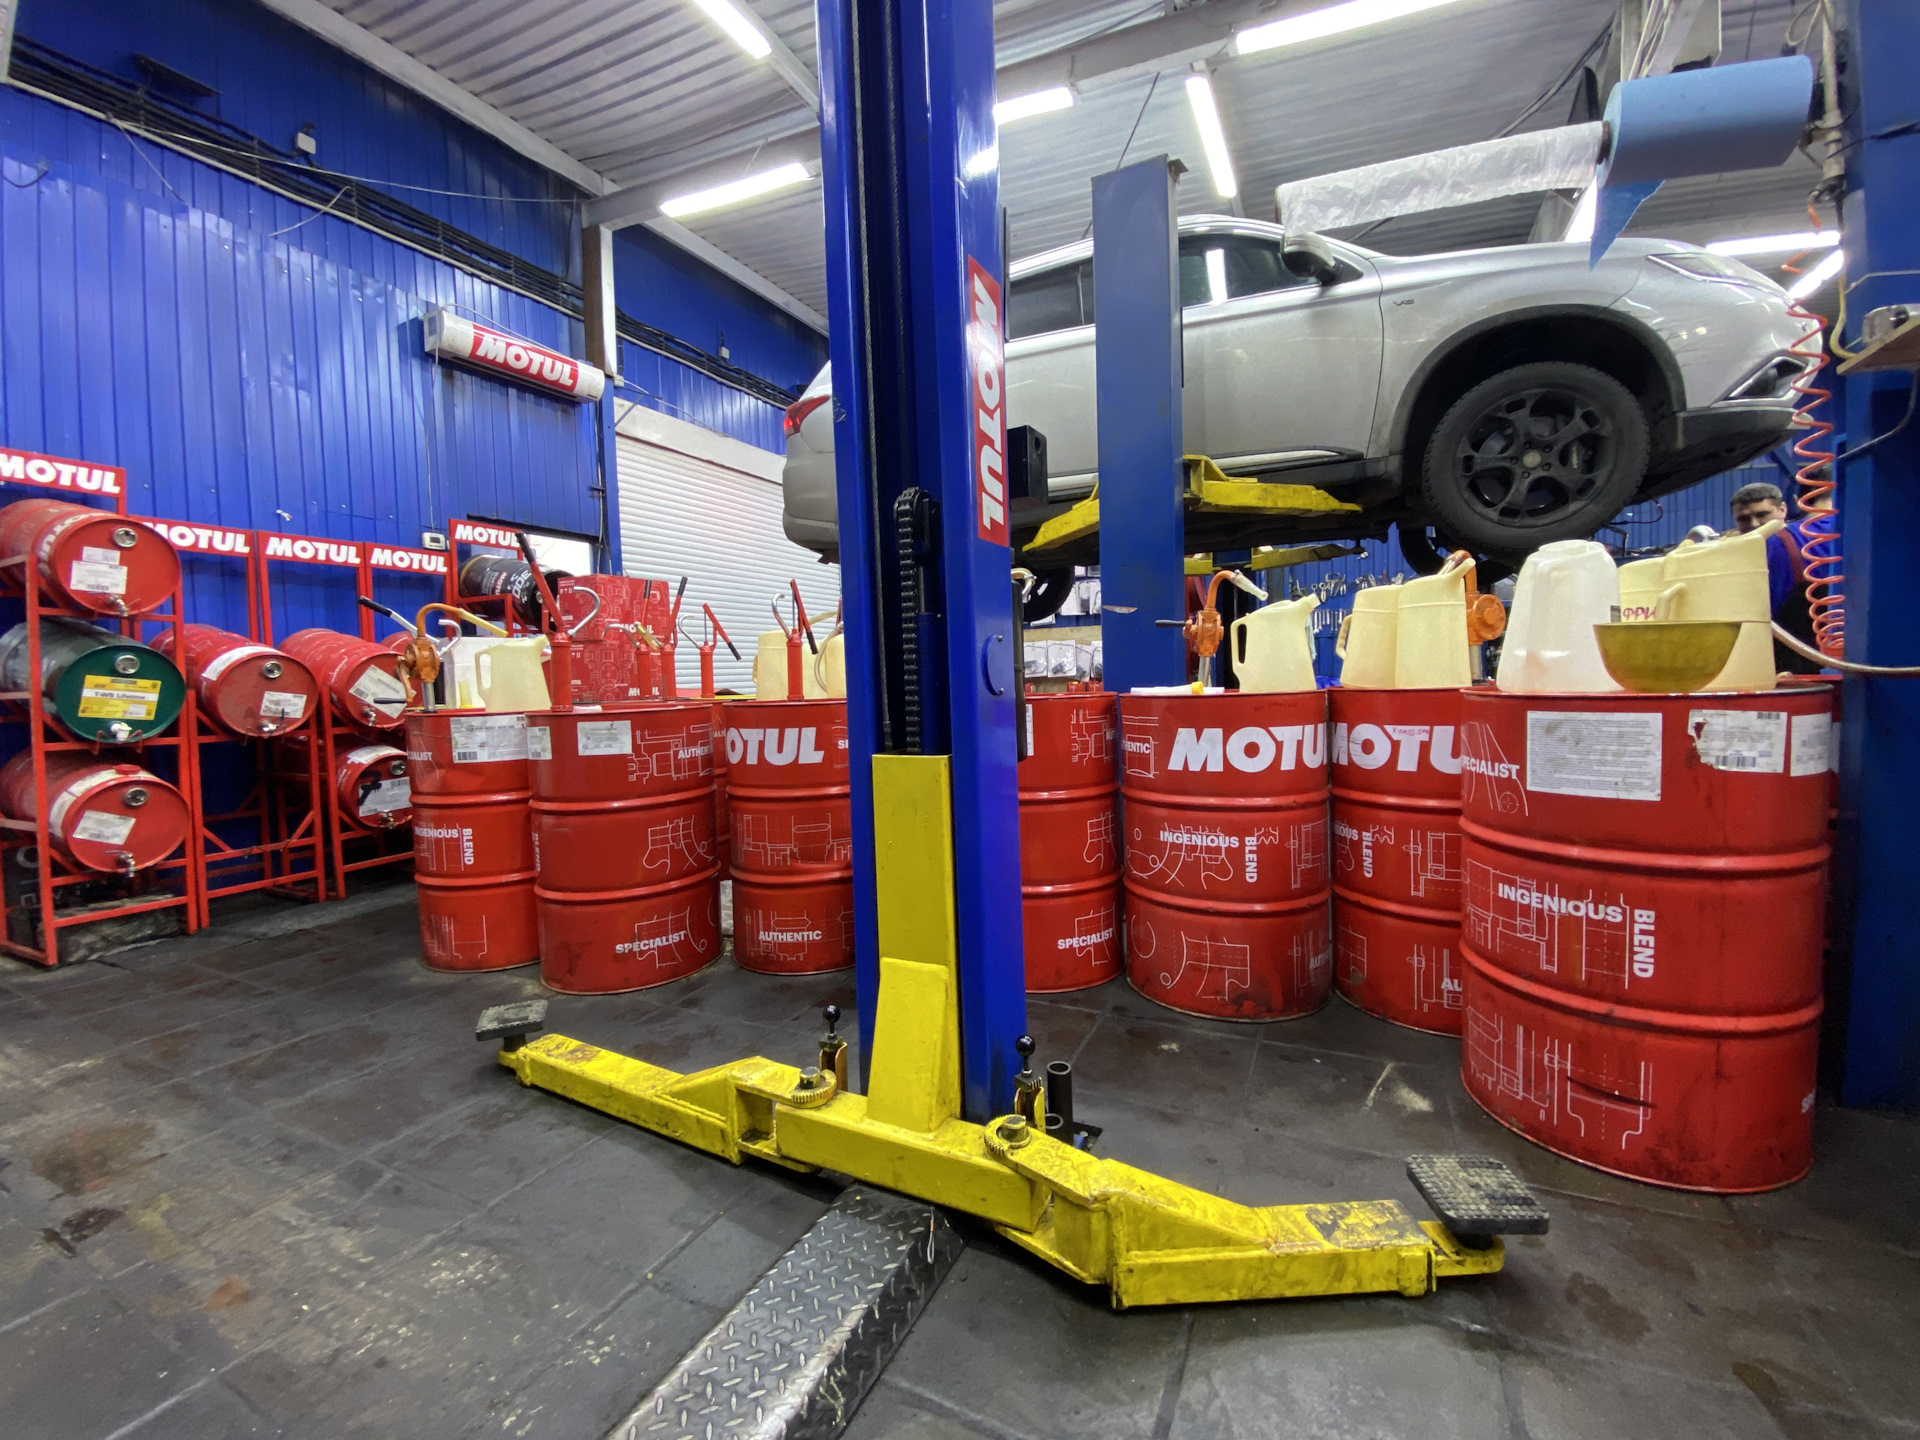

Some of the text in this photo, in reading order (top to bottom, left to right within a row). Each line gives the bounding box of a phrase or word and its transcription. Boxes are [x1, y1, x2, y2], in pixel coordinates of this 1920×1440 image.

[475, 332, 574, 387] MOTUL
[973, 272, 1004, 531] MOTUL
[0, 453, 121, 494] MOTUL
[265, 536, 361, 565] MOTUL
[455, 523, 520, 548] MOTUL
[370, 547, 448, 573] MOTUL
[726, 727, 825, 766] OTUL
[1167, 722, 1327, 773] MOTU
[1331, 722, 1462, 775] MOTU
[462, 828, 475, 866] BLEND
[1160, 830, 1240, 849] INGENIOUS
[1244, 836, 1258, 883] BLEND
[1361, 831, 1374, 878] BLEND
[1498, 882, 1624, 923] INGENIOUS
[615, 930, 687, 955] SPECIALIST
[758, 930, 823, 942] AUTHENTIC
[1057, 927, 1114, 950] SPECIALIST
[1633, 908, 1656, 978] BLEND
